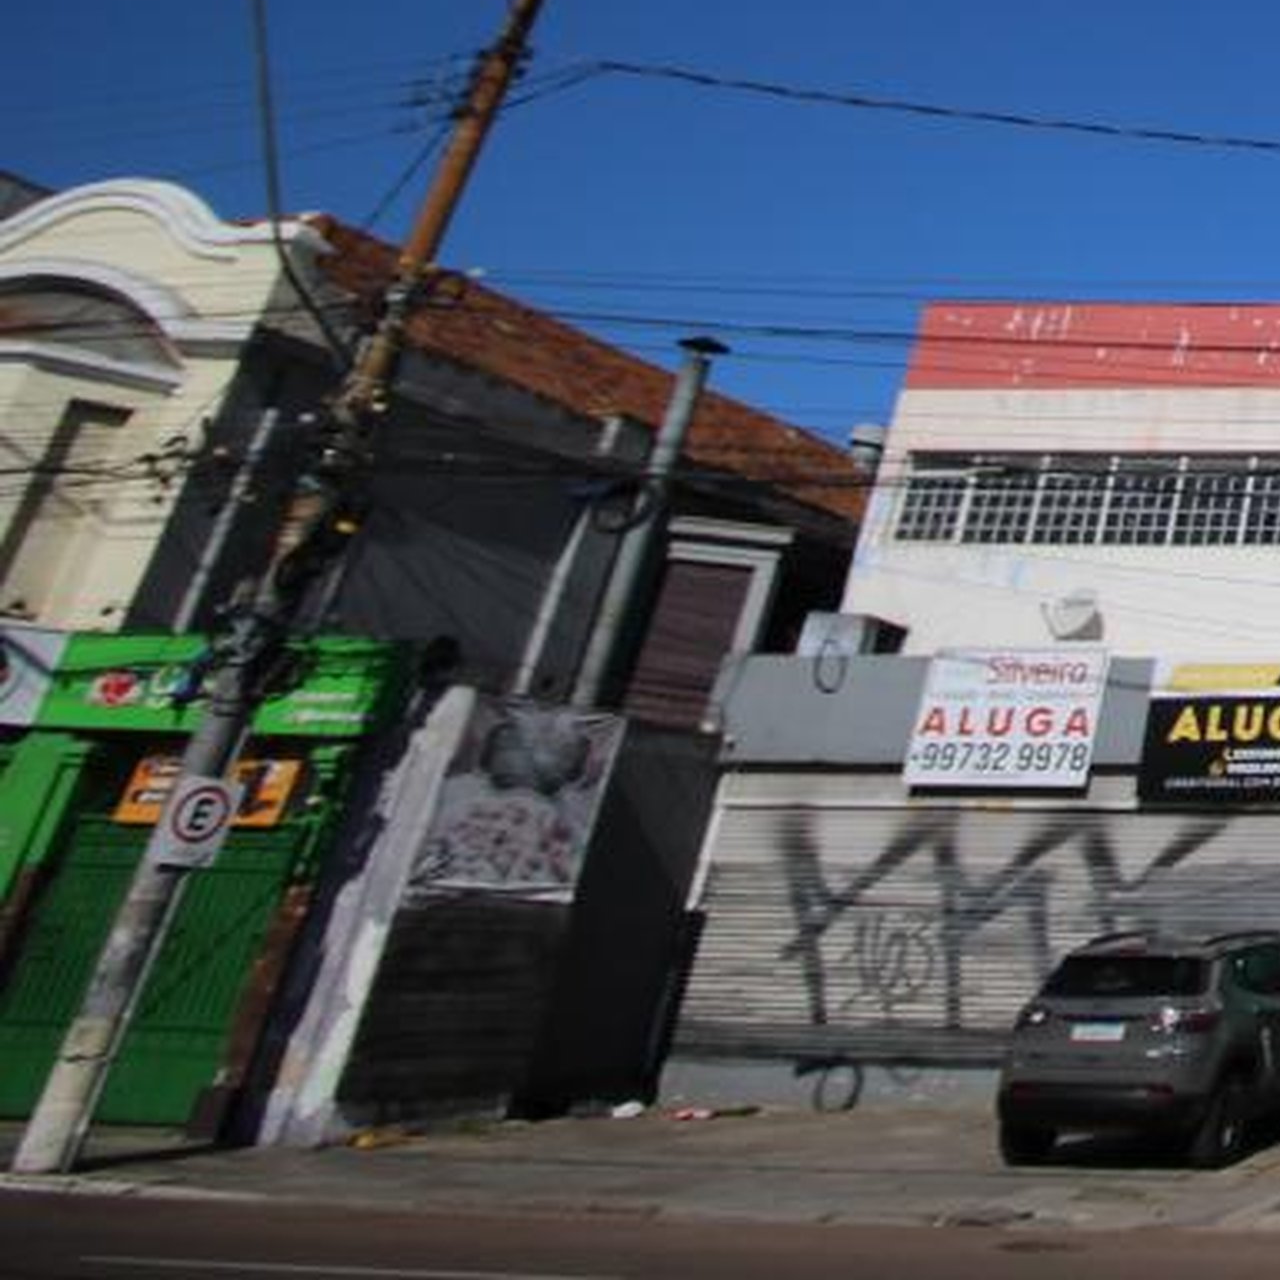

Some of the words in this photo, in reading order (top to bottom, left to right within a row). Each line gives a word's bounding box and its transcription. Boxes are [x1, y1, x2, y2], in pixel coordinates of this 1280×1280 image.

[918, 705, 1090, 737] ALUGA
[1016, 742, 1089, 771] 9978
[185, 796, 218, 831] E
